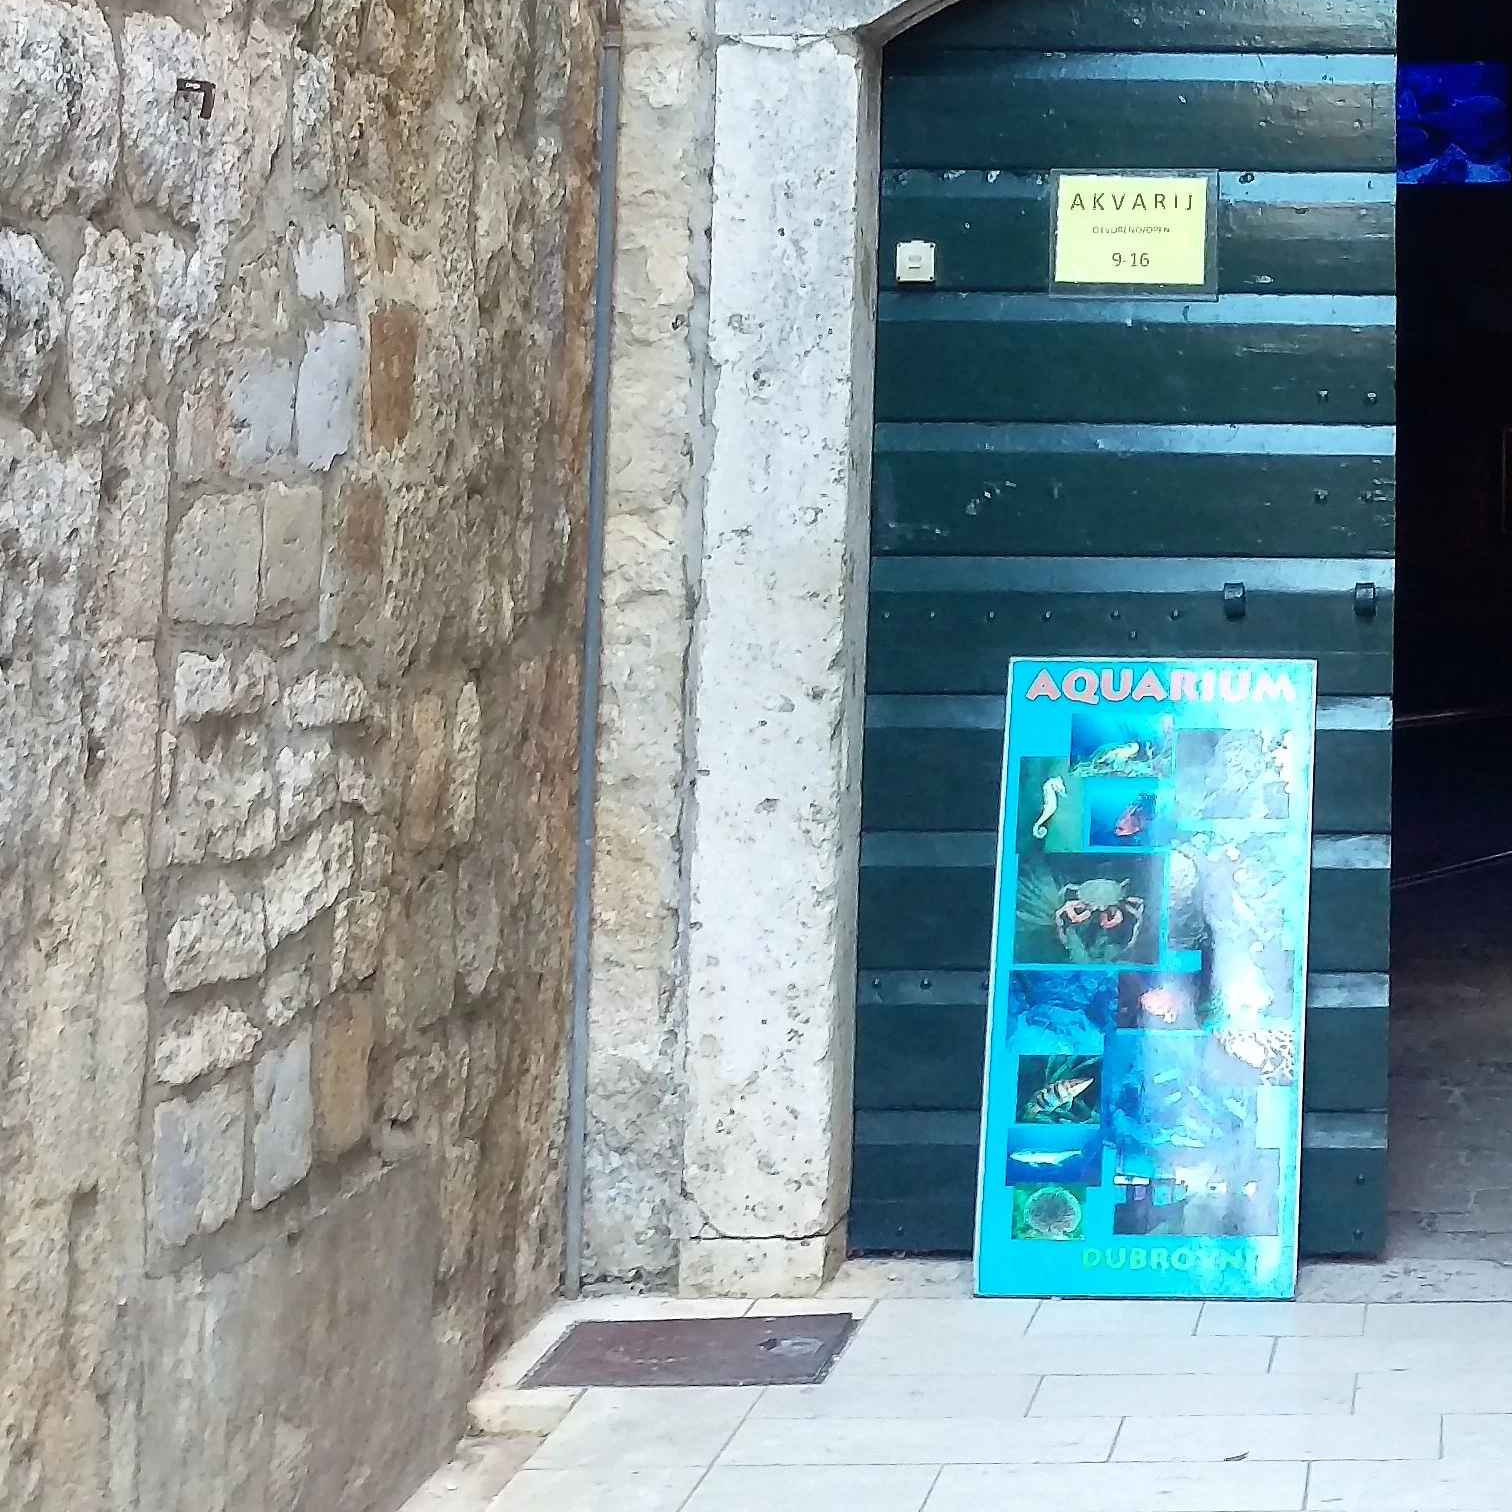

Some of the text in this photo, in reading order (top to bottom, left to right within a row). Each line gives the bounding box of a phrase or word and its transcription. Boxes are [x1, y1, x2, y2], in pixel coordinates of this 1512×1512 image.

[1069, 192, 1194, 212] AKVARIJ
[1110, 252, 1151, 268] 9-16
[1025, 666, 1298, 706] AQUARIUM
